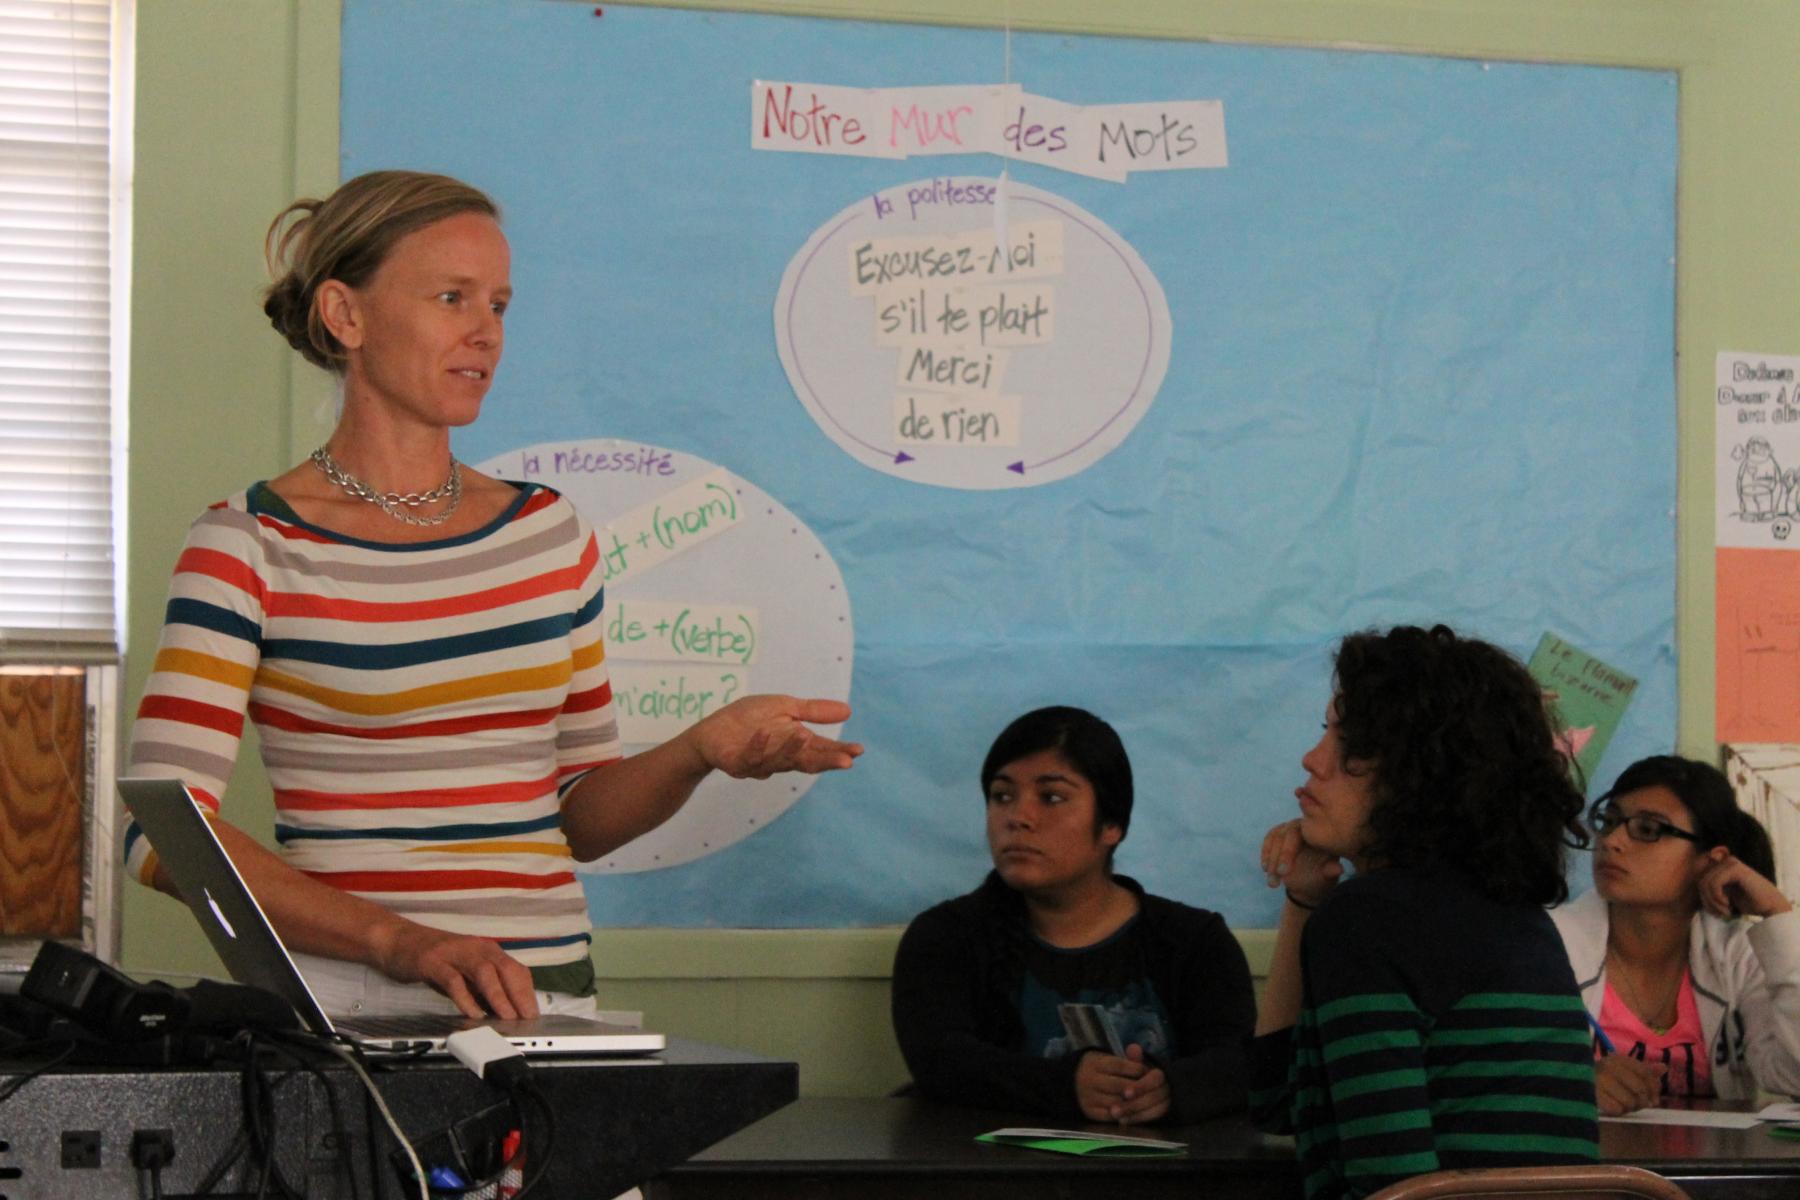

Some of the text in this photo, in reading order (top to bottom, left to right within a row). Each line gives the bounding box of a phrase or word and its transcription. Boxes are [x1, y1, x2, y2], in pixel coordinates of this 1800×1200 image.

[763, 85, 1197, 162] Notre Mur des Mots
[871, 180, 997, 220] la politesse
[880, 289, 927, 334] s'il
[936, 294, 969, 336] te
[906, 348, 993, 389] Merci
[900, 398, 999, 443] de rien
[522, 448, 676, 479] la nécessité
[608, 603, 648, 644] de
